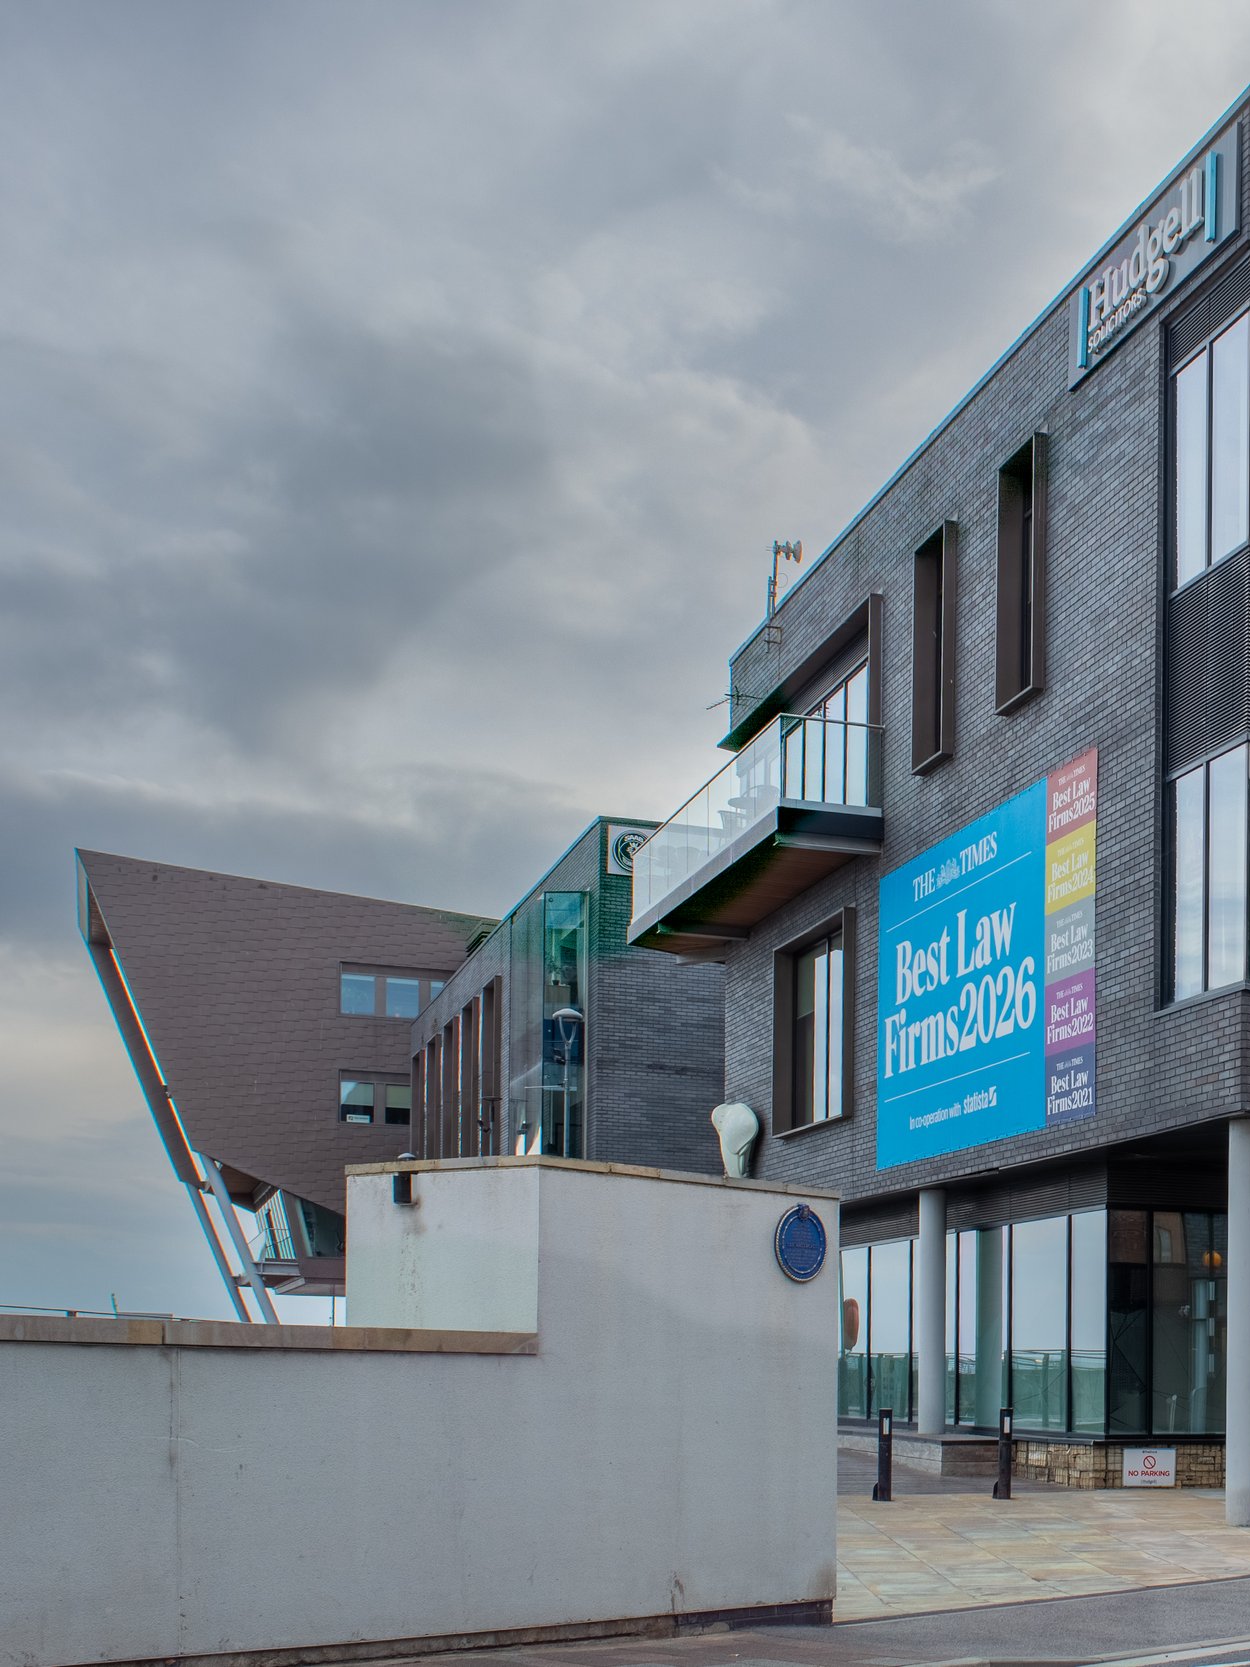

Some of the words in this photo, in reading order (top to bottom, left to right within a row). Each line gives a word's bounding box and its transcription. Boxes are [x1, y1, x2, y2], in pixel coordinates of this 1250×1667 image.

[1088, 168, 1204, 332] Hudgell
[1088, 288, 1147, 354] SOLICITORS
[1053, 785, 1071, 811] Best
[1072, 777, 1091, 800] Law
[913, 868, 936, 902] THE
[959, 831, 998, 876] TIMES
[1052, 858, 1070, 881] Best
[1071, 850, 1089, 872] Law
[895, 926, 950, 1005] Best
[956, 902, 1017, 978] Law
[1051, 929, 1069, 952] Best
[1071, 923, 1088, 944] Law
[1051, 1001, 1069, 1023] Best
[1071, 996, 1088, 1016] Law
[1051, 1073, 1069, 1095] Best
[1071, 1070, 1089, 1089] Law
[910, 1115, 916, 1131] In
[915, 1107, 949, 1129] co-operation
[949, 1102, 962, 1118] with
[963, 1089, 989, 1114] statista
